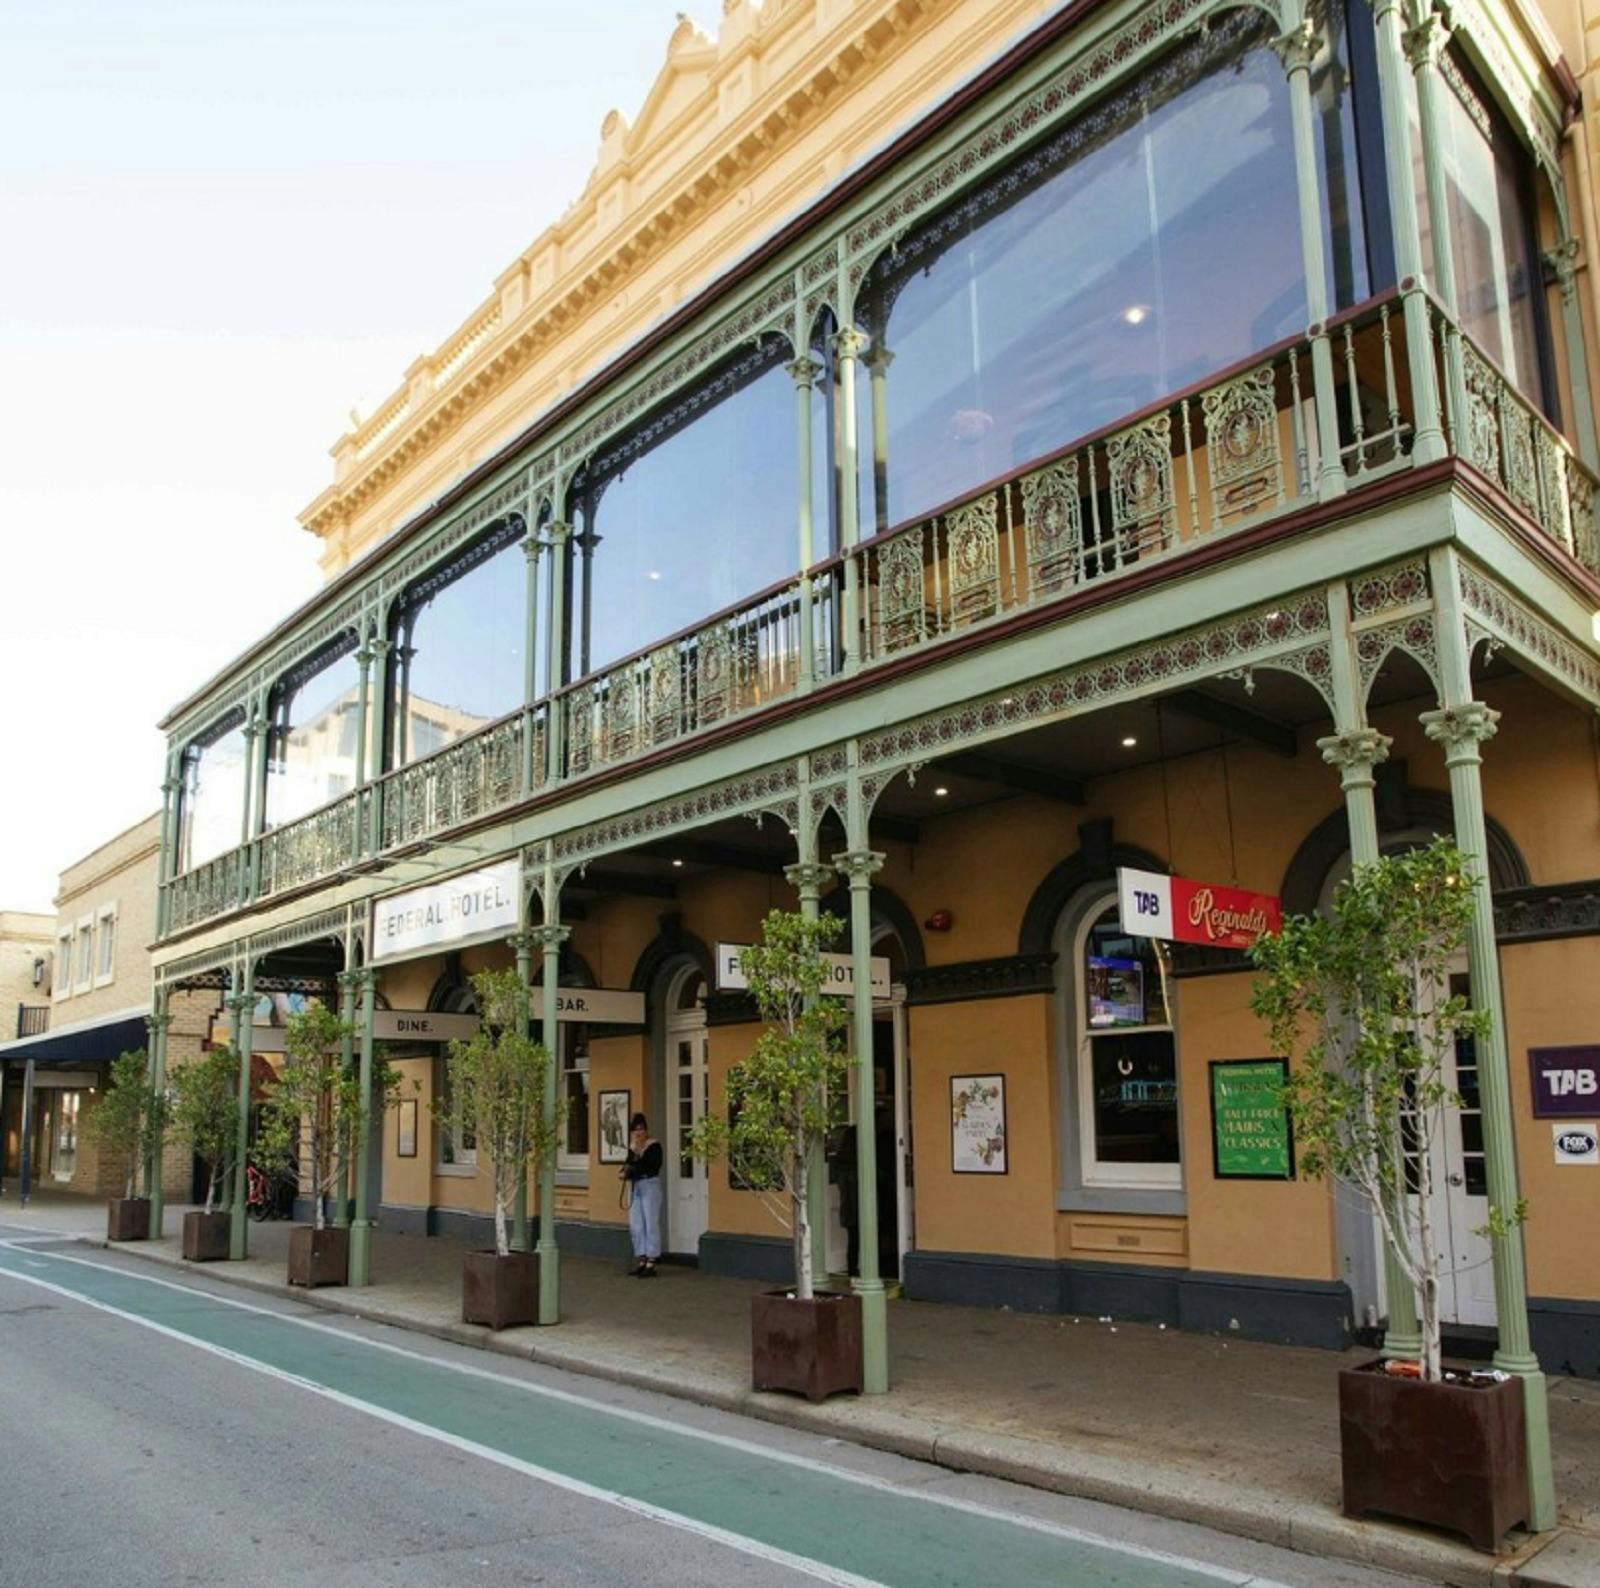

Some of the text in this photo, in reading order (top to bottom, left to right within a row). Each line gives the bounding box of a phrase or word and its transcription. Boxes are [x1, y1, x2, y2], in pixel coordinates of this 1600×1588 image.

[1133, 890, 1160, 916] TAB
[556, 997, 589, 1012] BAR.
[397, 1019, 434, 1032] DINE.
[1542, 1069, 1598, 1095] TAB
